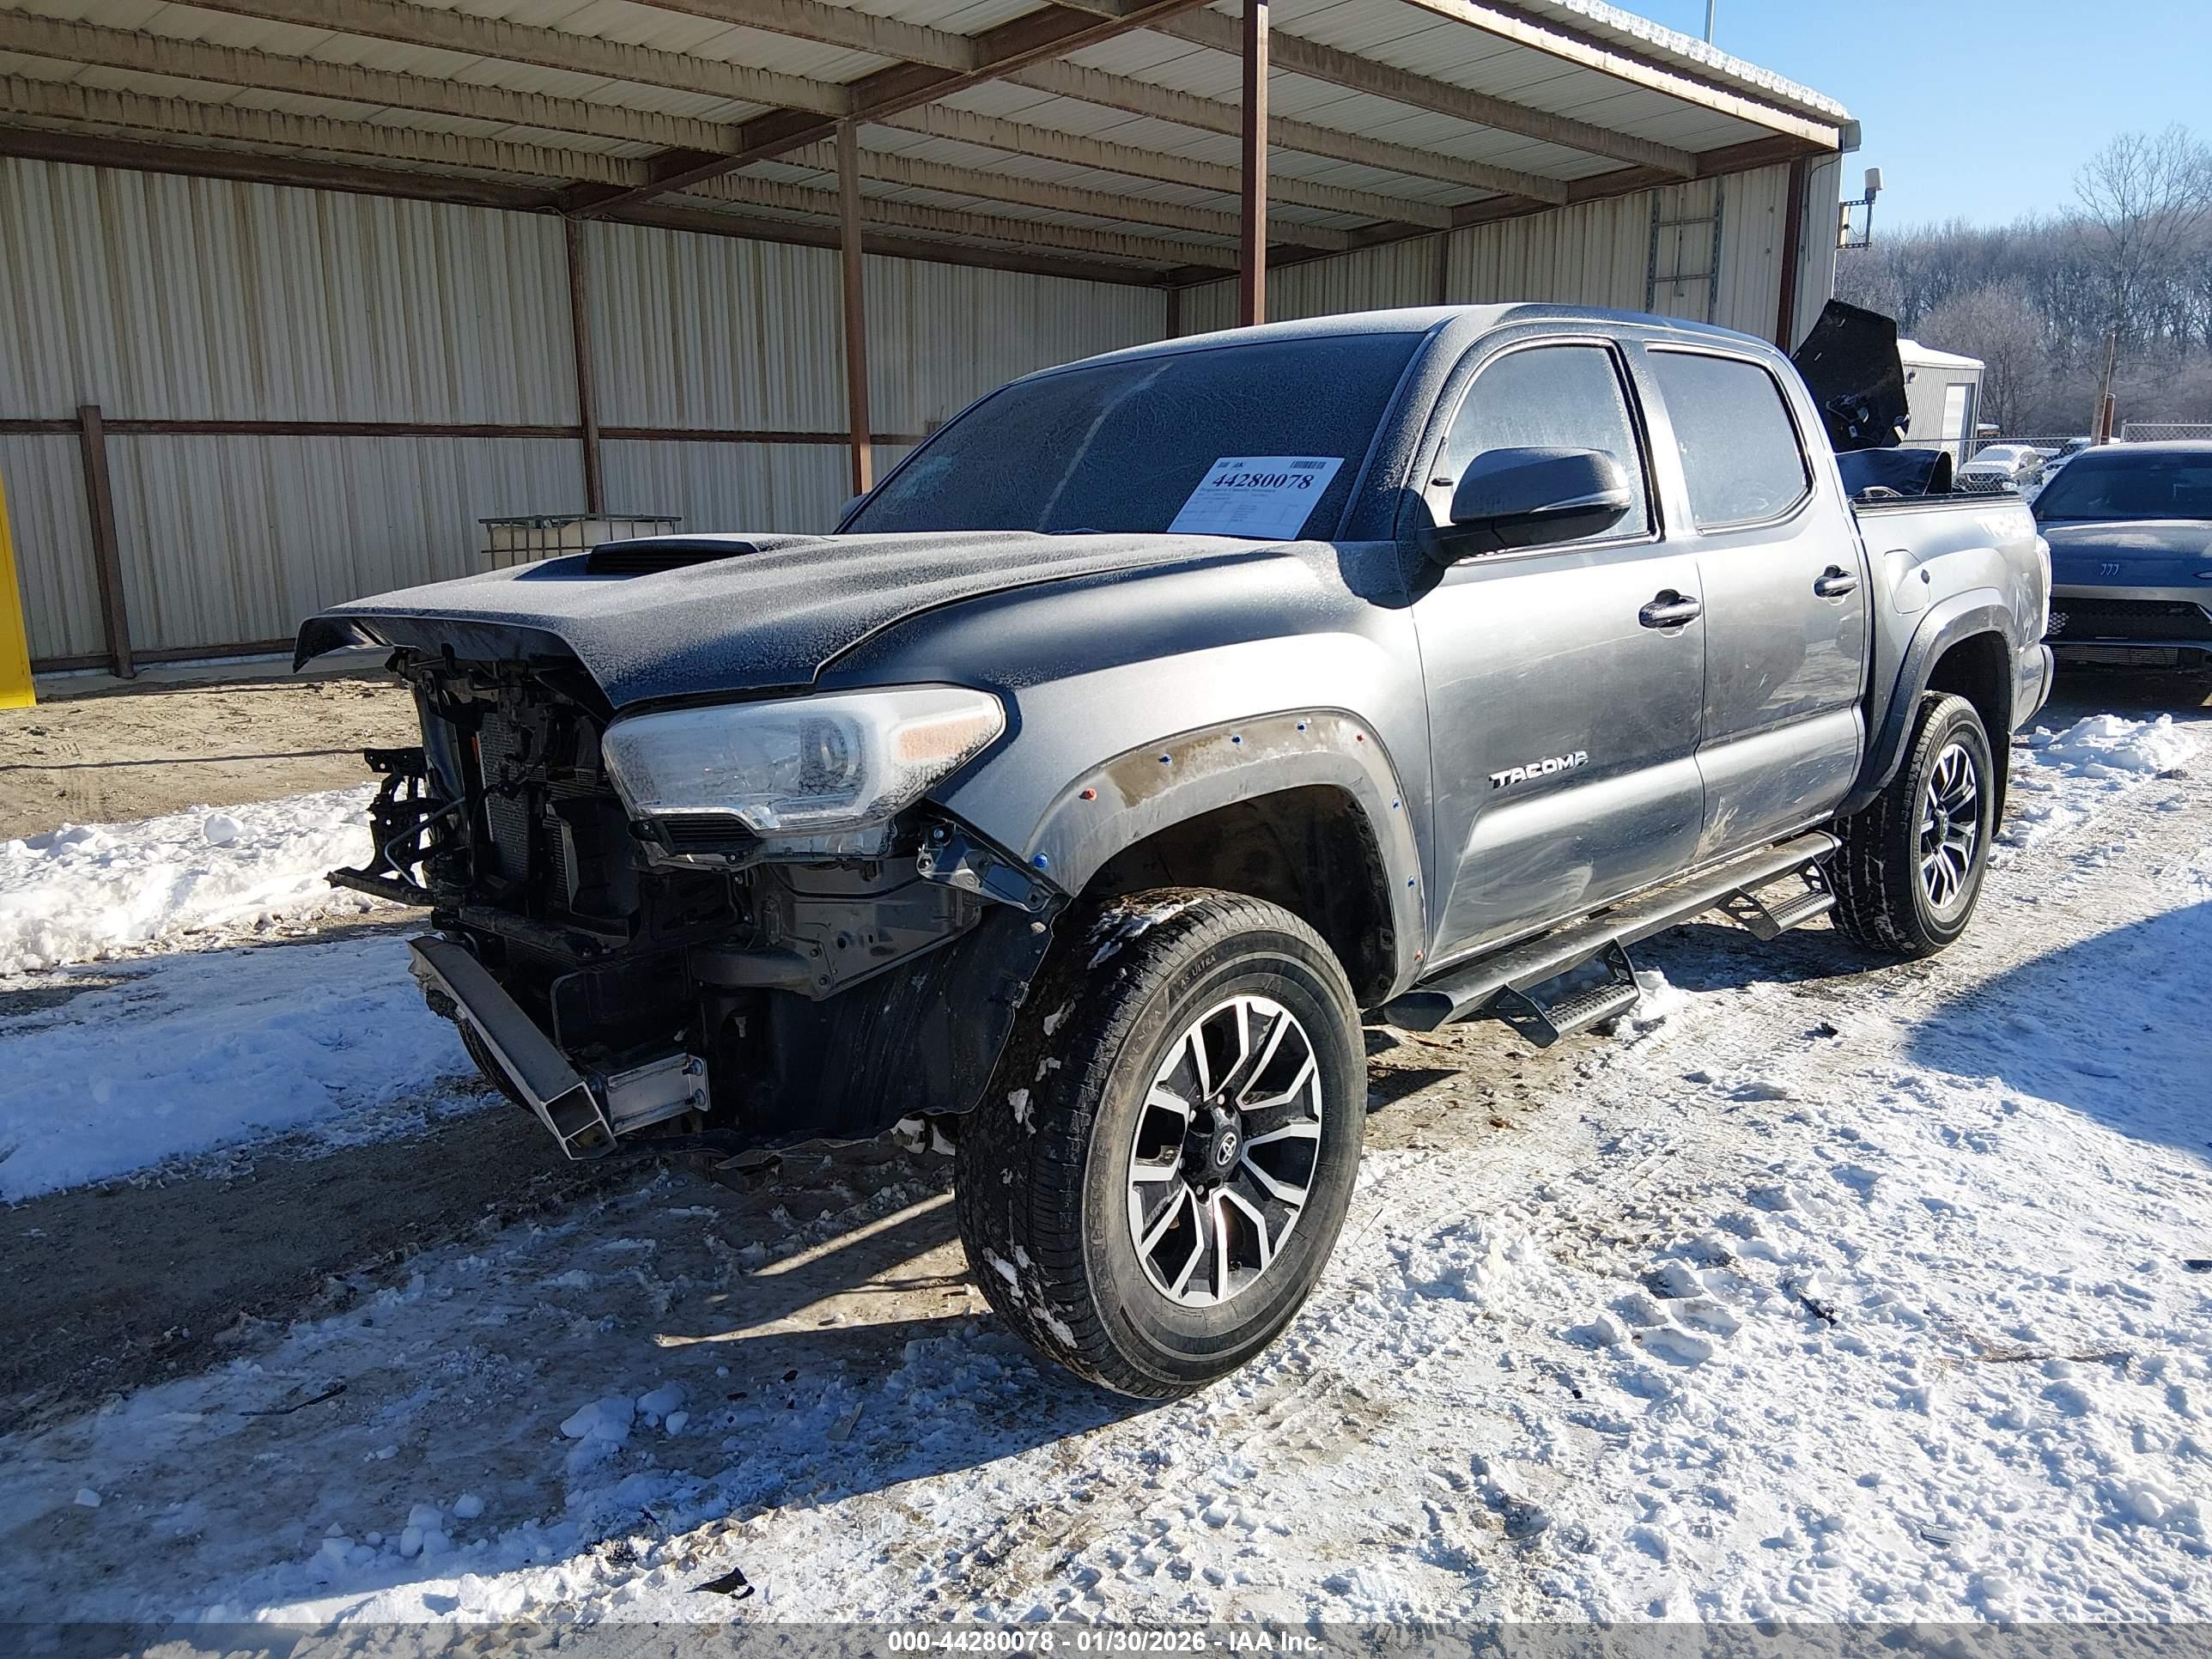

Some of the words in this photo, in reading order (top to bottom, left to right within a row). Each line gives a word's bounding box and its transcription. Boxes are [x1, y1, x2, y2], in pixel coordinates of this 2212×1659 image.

[1212, 473, 1315, 489] 44280078
[1489, 750, 1589, 788] TACOMA
[1192, 954, 1217, 977] ULTRA
